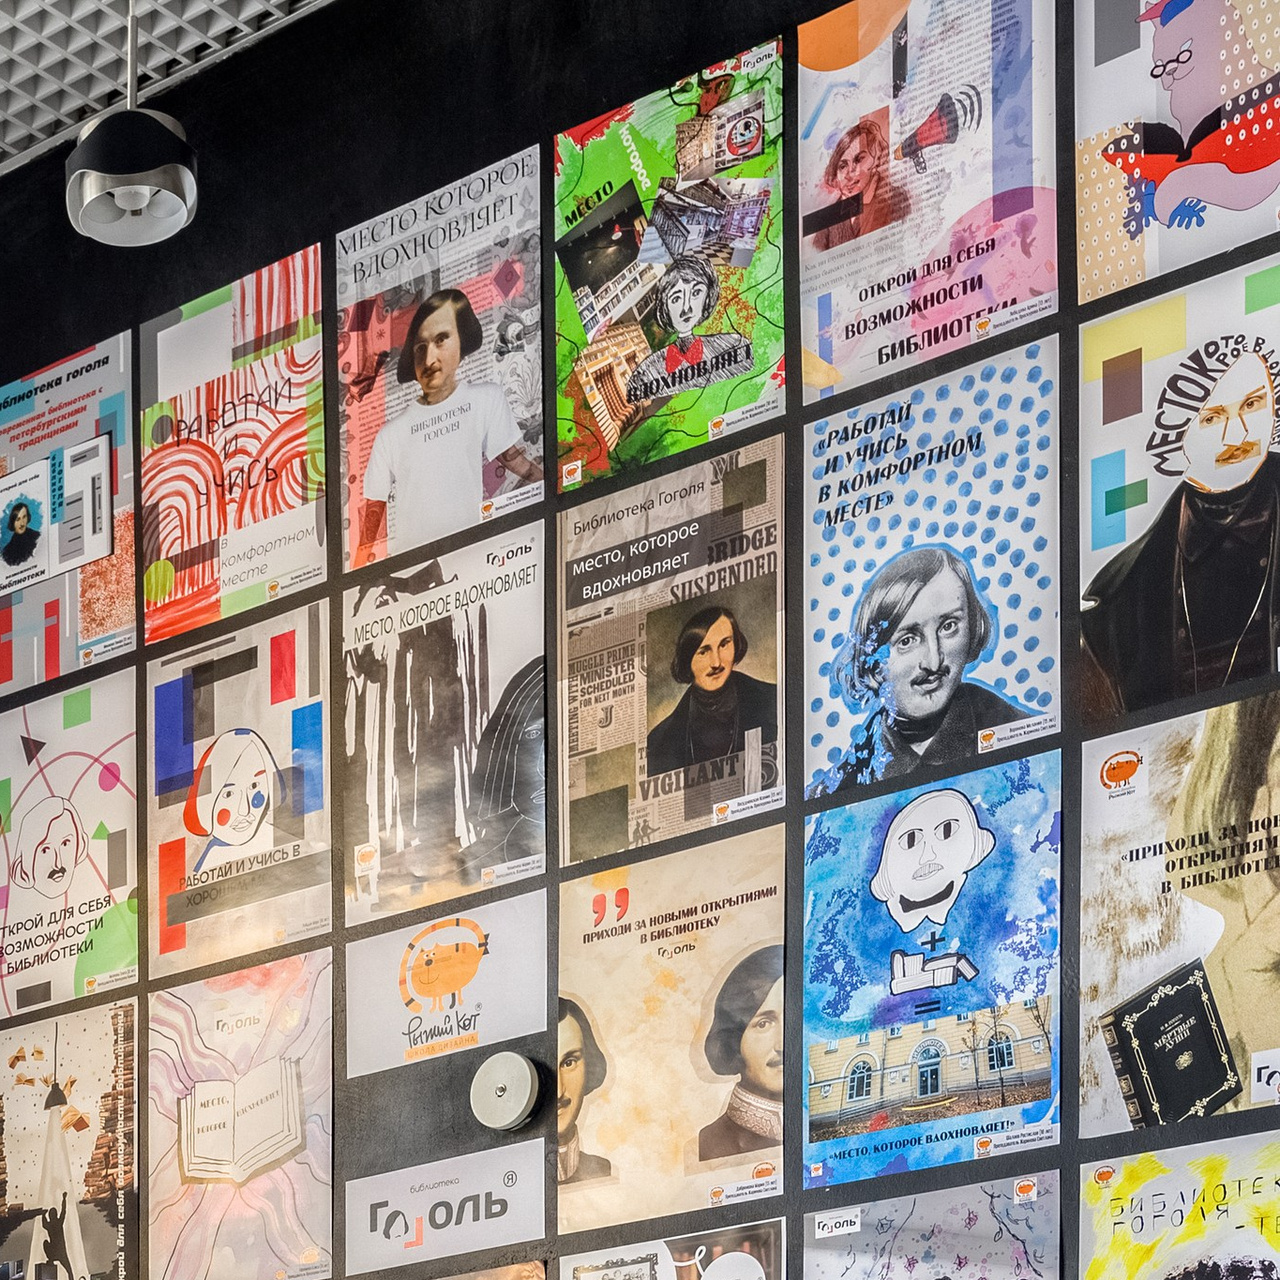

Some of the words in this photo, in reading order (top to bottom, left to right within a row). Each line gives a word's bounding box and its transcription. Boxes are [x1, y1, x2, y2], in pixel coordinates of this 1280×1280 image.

[338, 207, 417, 259] МЕСТО
[425, 154, 534, 220] КОТОРОЕ
[353, 193, 518, 283] ВДОХНОВЛЯЕТ
[858, 264, 917, 303] ОТКРОЙ
[921, 253, 953, 280] ДЛЯ
[956, 237, 997, 267] СЕБЯ
[844, 273, 984, 341] ВОЗМОЖНОСТИ
[67, 355, 109, 385] гоголя
[410, 401, 472, 436] БИБЛИОТЕКА
[818, 401, 913, 454] «РАБОТАЙ
[196, 458, 278, 509] УЧИСЬ
[837, 431, 983, 498] КОМФОРТНОМ
[573, 498, 655, 536] Библиотека
[658, 479, 705, 508] Гоголя
[823, 493, 896, 529] МЕСТЕ»
[221, 524, 315, 568] комфортном
[571, 549, 625, 576] место,
[629, 521, 700, 557] которое
[221, 563, 268, 589] месте
[582, 552, 691, 600] вдохновляет
[354, 616, 396, 645] МЕСТО,
[400, 594, 451, 627] КОТОРОЕ
[455, 563, 537, 610] ВДОХНОВЛЯЕТ
[579, 660, 635, 687] MINISTER
[639, 754, 740, 801] VIGILANT
[1217, 822, 1239, 840] ЗА
[179, 860, 233, 891] РАБОТАЙ
[248, 847, 289, 869] УЧИСЬ
[47, 907, 74, 927] ДЛЯ
[78, 895, 111, 917] СЕБЯ
[583, 923, 632, 945] ПРИХОДИ
[650, 906, 698, 929] НОВЫМИ
[701, 885, 778, 915] ОТКРЫТИЯМИ
[650, 916, 720, 943] БИБЛИОТЕКУ
[7, 938, 94, 976] БИБЛИОТЕКИ
[873, 1136, 924, 1156] КОТОРОЕ
[409, 1176, 460, 1194] библиотека
